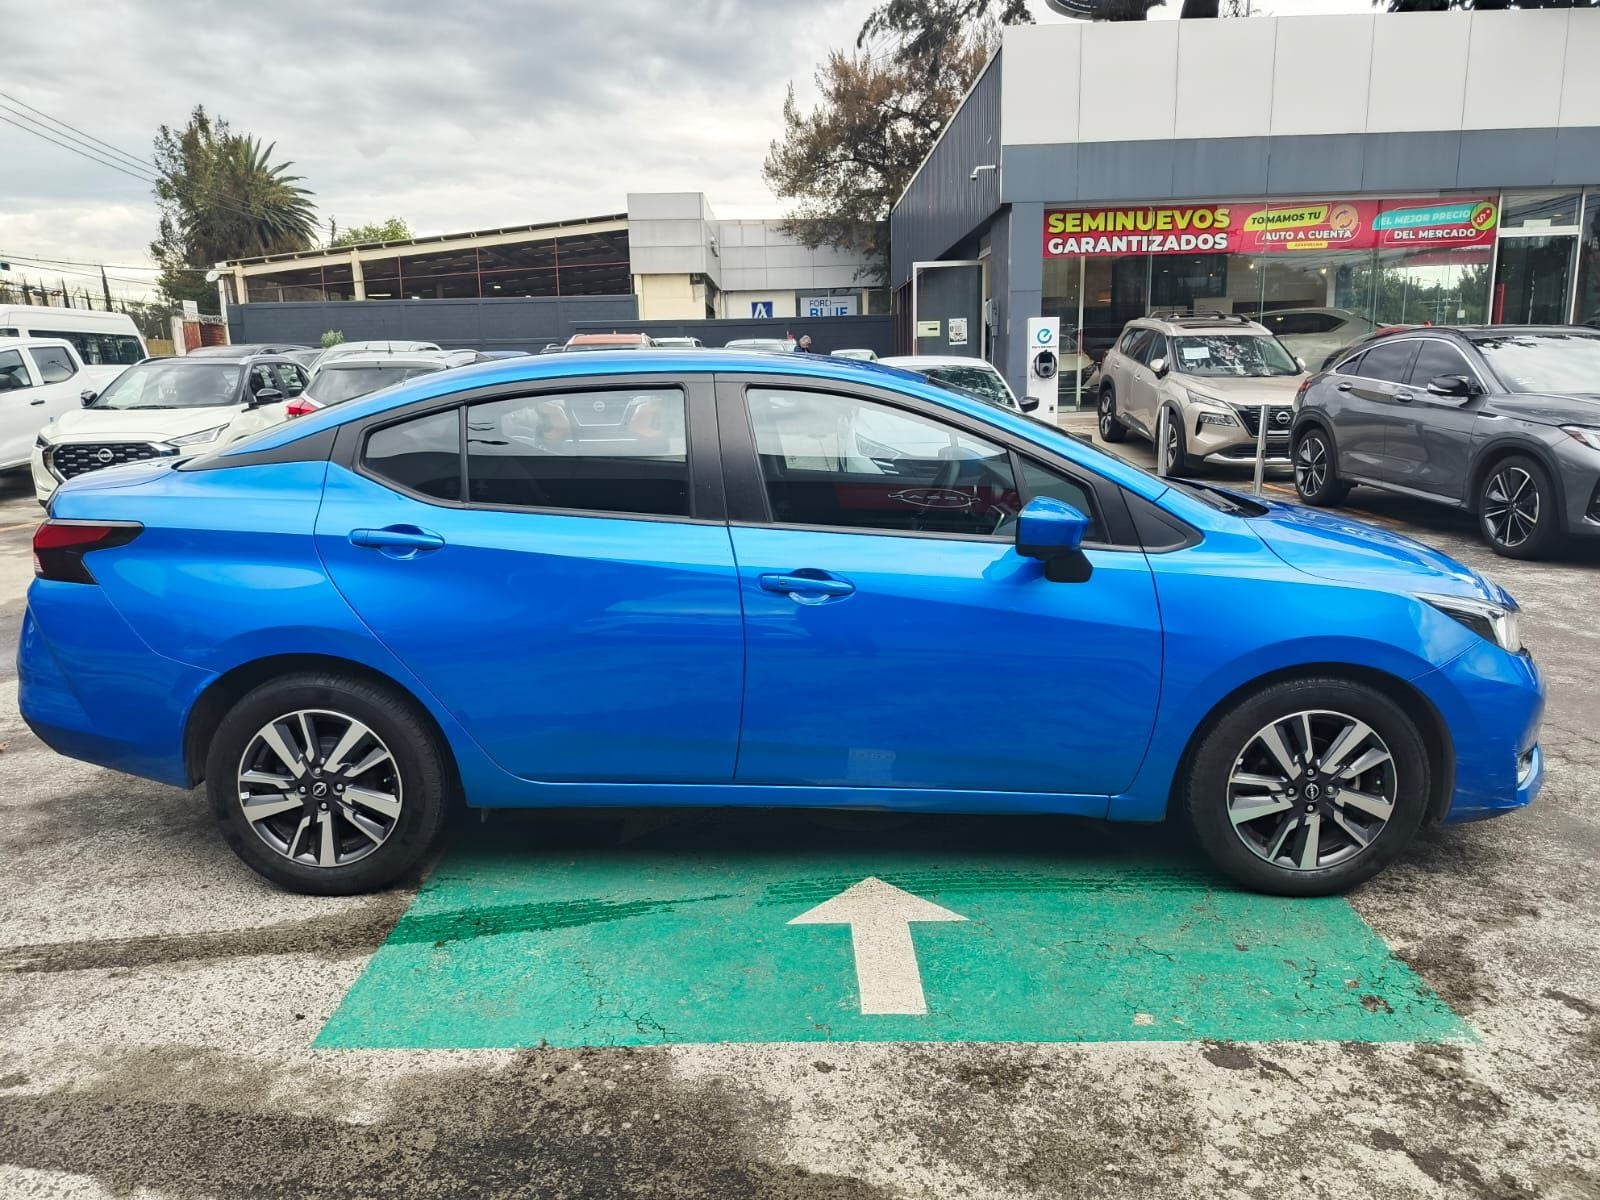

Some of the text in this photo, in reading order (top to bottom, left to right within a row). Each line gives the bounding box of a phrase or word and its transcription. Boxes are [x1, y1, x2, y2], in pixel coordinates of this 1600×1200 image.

[1048, 208, 1230, 233] SEMINUEVOS
[1251, 211, 1321, 225] TOMAMOS TU
[1381, 209, 1470, 226] EL MEJOR PRECIO
[1262, 229, 1352, 240] AUTO A CUENTA
[1394, 228, 1476, 240] DEL MERCADO
[1047, 233, 1228, 254] GARANTIZADOS
[809, 299, 831, 307] FORD
